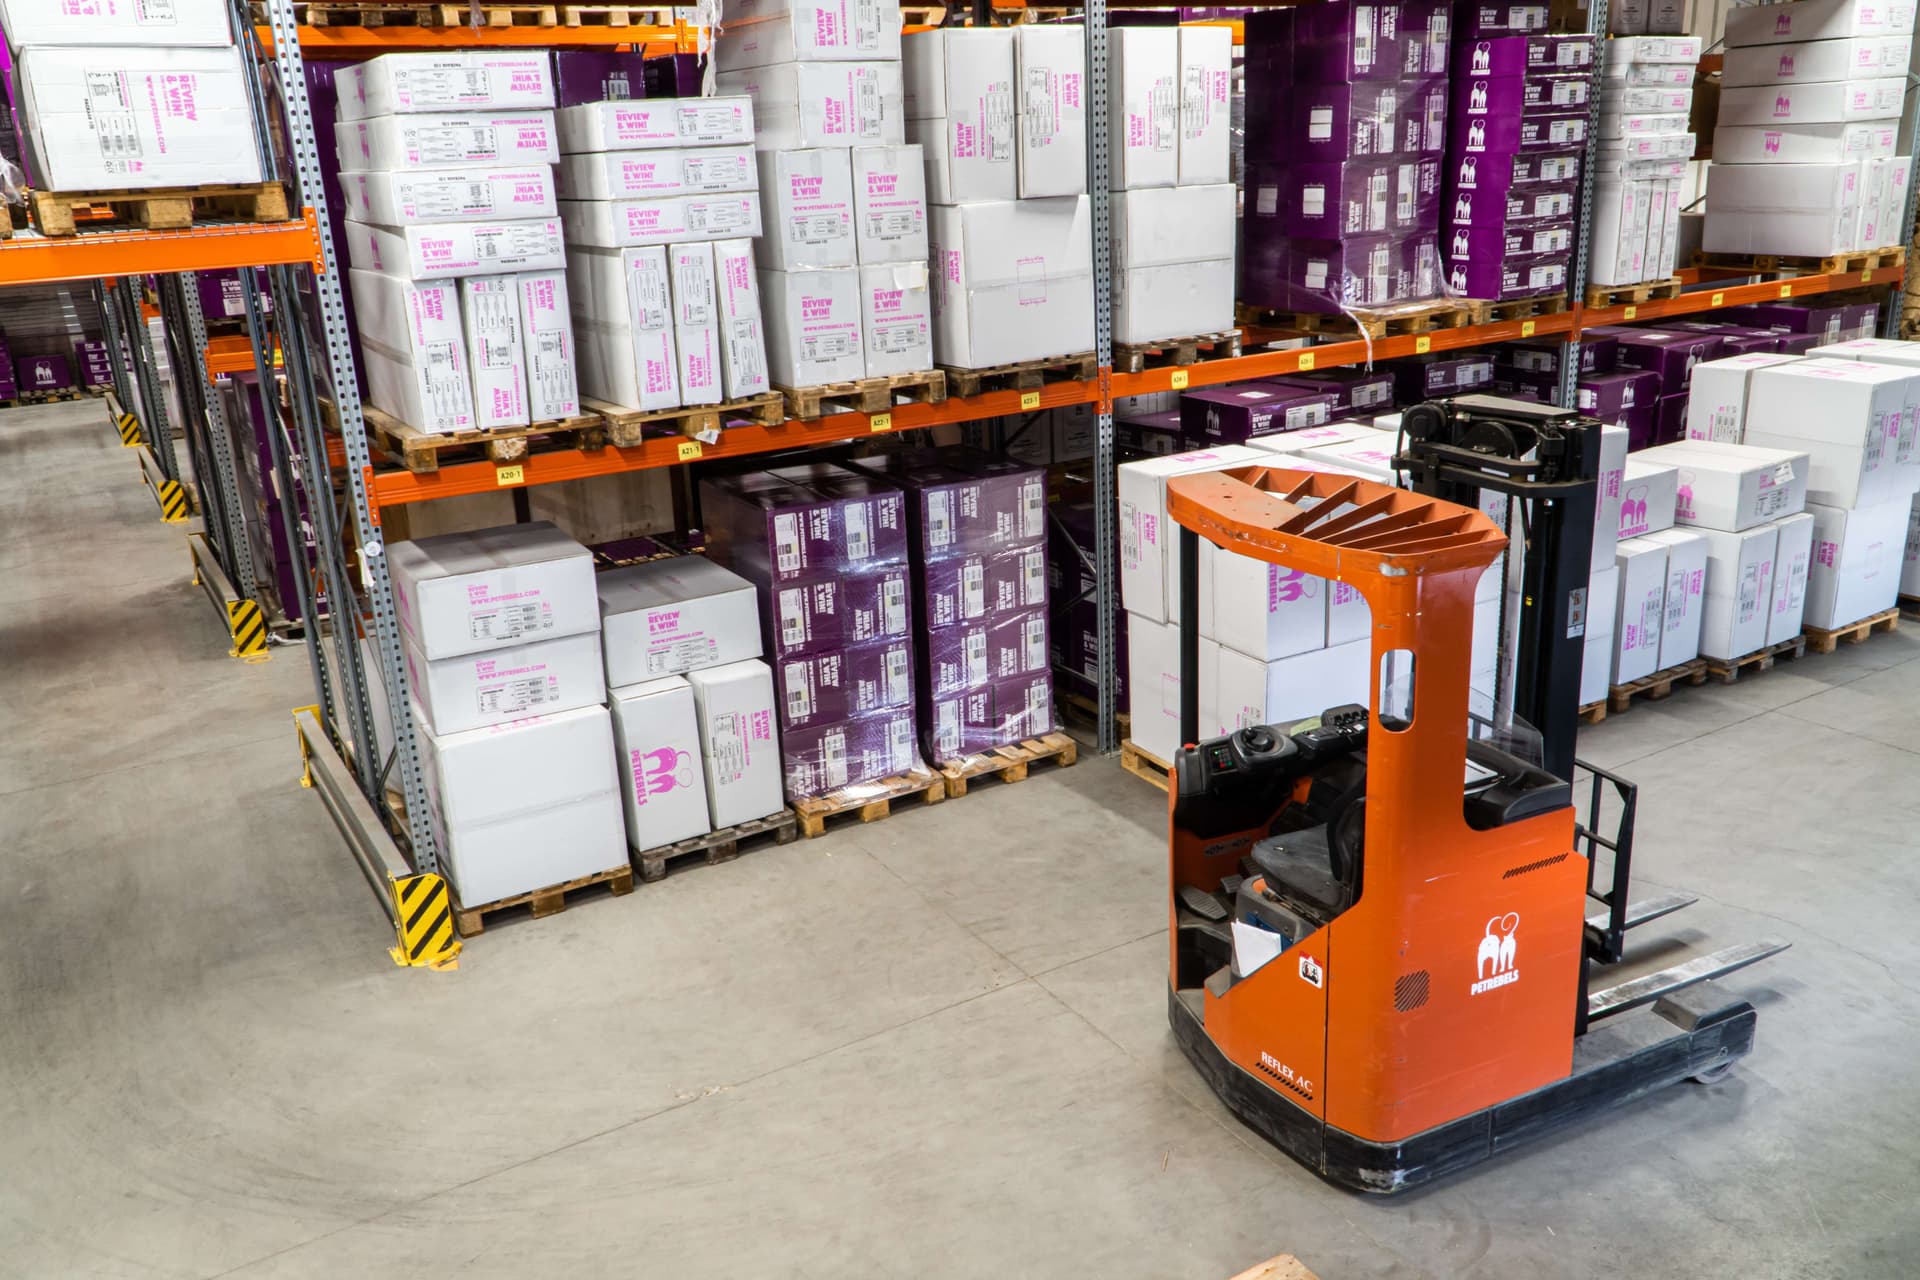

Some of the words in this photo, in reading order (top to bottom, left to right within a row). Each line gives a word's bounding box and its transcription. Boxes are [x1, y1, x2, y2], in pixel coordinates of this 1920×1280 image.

[816, 8, 826, 46] REVIEW
[826, 12, 834, 38] WIN!
[166, 76, 176, 84] &
[510, 83, 542, 91] REVIEW
[1072, 74, 1080, 108] REVIEW
[170, 88, 184, 117] WIN!
[178, 75, 198, 121] REVIEW
[616, 113, 650, 121] REVIEW
[516, 140, 548, 148] REVIEW
[957, 122, 965, 158] REVIEW
[622, 164, 656, 172] REVIEW
[633, 172, 654, 180] WIN!
[791, 176, 822, 186] REVIEW
[868, 175, 898, 184] REVIEW
[514, 194, 544, 202] REVIEW
[800, 188, 820, 196] WIN!
[876, 185, 895, 193] WIN!
[628, 210, 660, 218] REVIEW
[637, 218, 658, 226] WIN!
[421, 240, 454, 250] REVIEW
[432, 288, 444, 320] REVIEW
[545, 280, 555, 311] REVIEW
[802, 298, 832, 308] REVIEW
[874, 290, 904, 300] REVIEW
[811, 308, 830, 316] WIN!
[647, 360, 656, 394] REVIEW
[689, 354, 697, 388] REVIEW
[494, 388, 502, 418] REVIEW
[820, 508, 830, 542] REVIEW
[888, 498, 897, 530] REVIEW
[825, 582, 834, 615] REVIEW
[1269, 562, 1278, 612] ETREBELS
[648, 610, 680, 624] REVIEW
[650, 624, 656, 632] &
[658, 620, 678, 630] WIN!
[830, 656, 840, 687] REVIEW
[760, 710, 770, 740] REVIEW
[630, 750, 648, 806] PETREBELS
[1471, 970, 1519, 996] PETREBELS
[1261, 1051, 1294, 1081] REFLEX
[1295, 1075, 1314, 1092] AC
